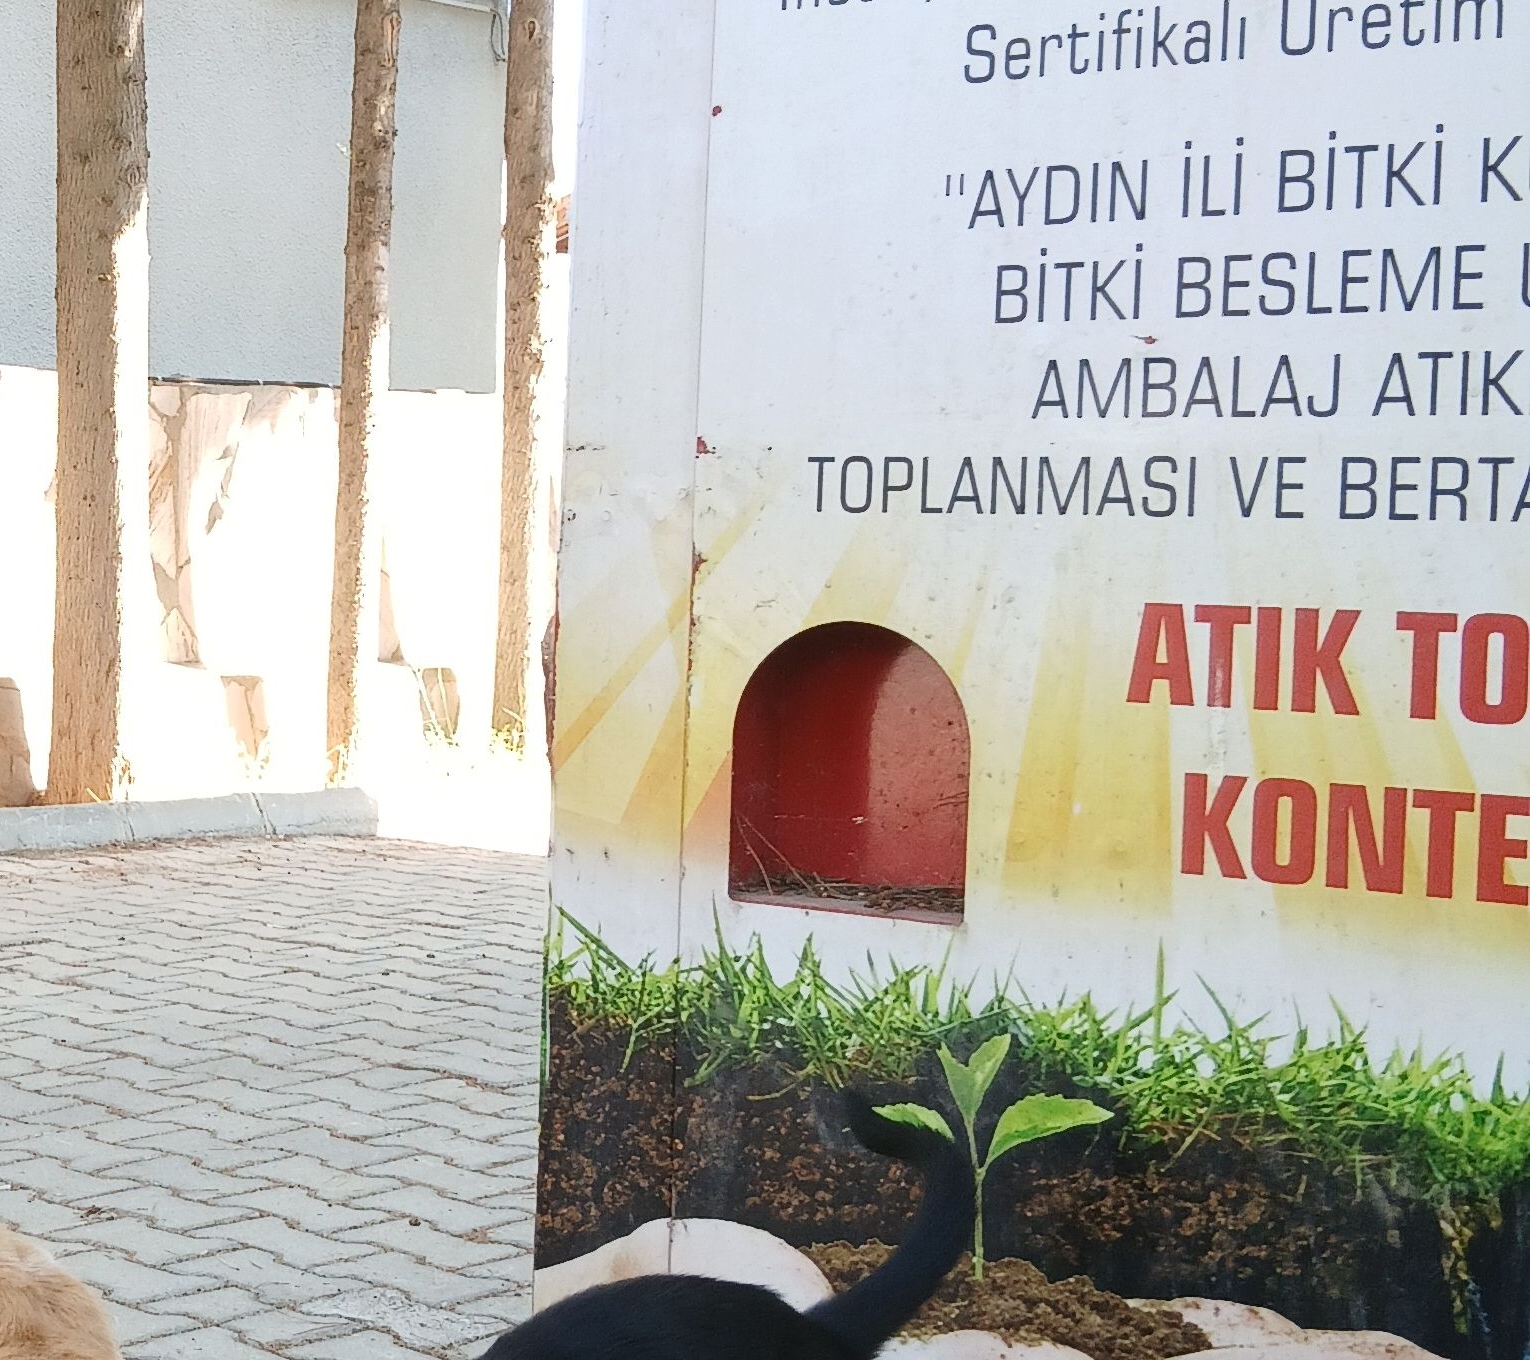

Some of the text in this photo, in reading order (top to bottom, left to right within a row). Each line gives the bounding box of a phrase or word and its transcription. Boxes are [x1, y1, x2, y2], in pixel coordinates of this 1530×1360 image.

[965, 0, 1247, 84] Sertifikalı
[1181, 137, 1244, 218] İLİ
[1277, 124, 1443, 214] BİTKİ
[1480, 135, 1530, 203] K
[994, 243, 1144, 324] BİTKİ
[1175, 245, 1487, 319] BESLEME
[1032, 349, 1530, 420] AMBALAJ ATIK
[807, 455, 1197, 518] TOPLANMASI
[1230, 456, 1307, 519] VE
[1126, 602, 1530, 725] ATIK TO
[1181, 772, 1530, 907] KONTE
